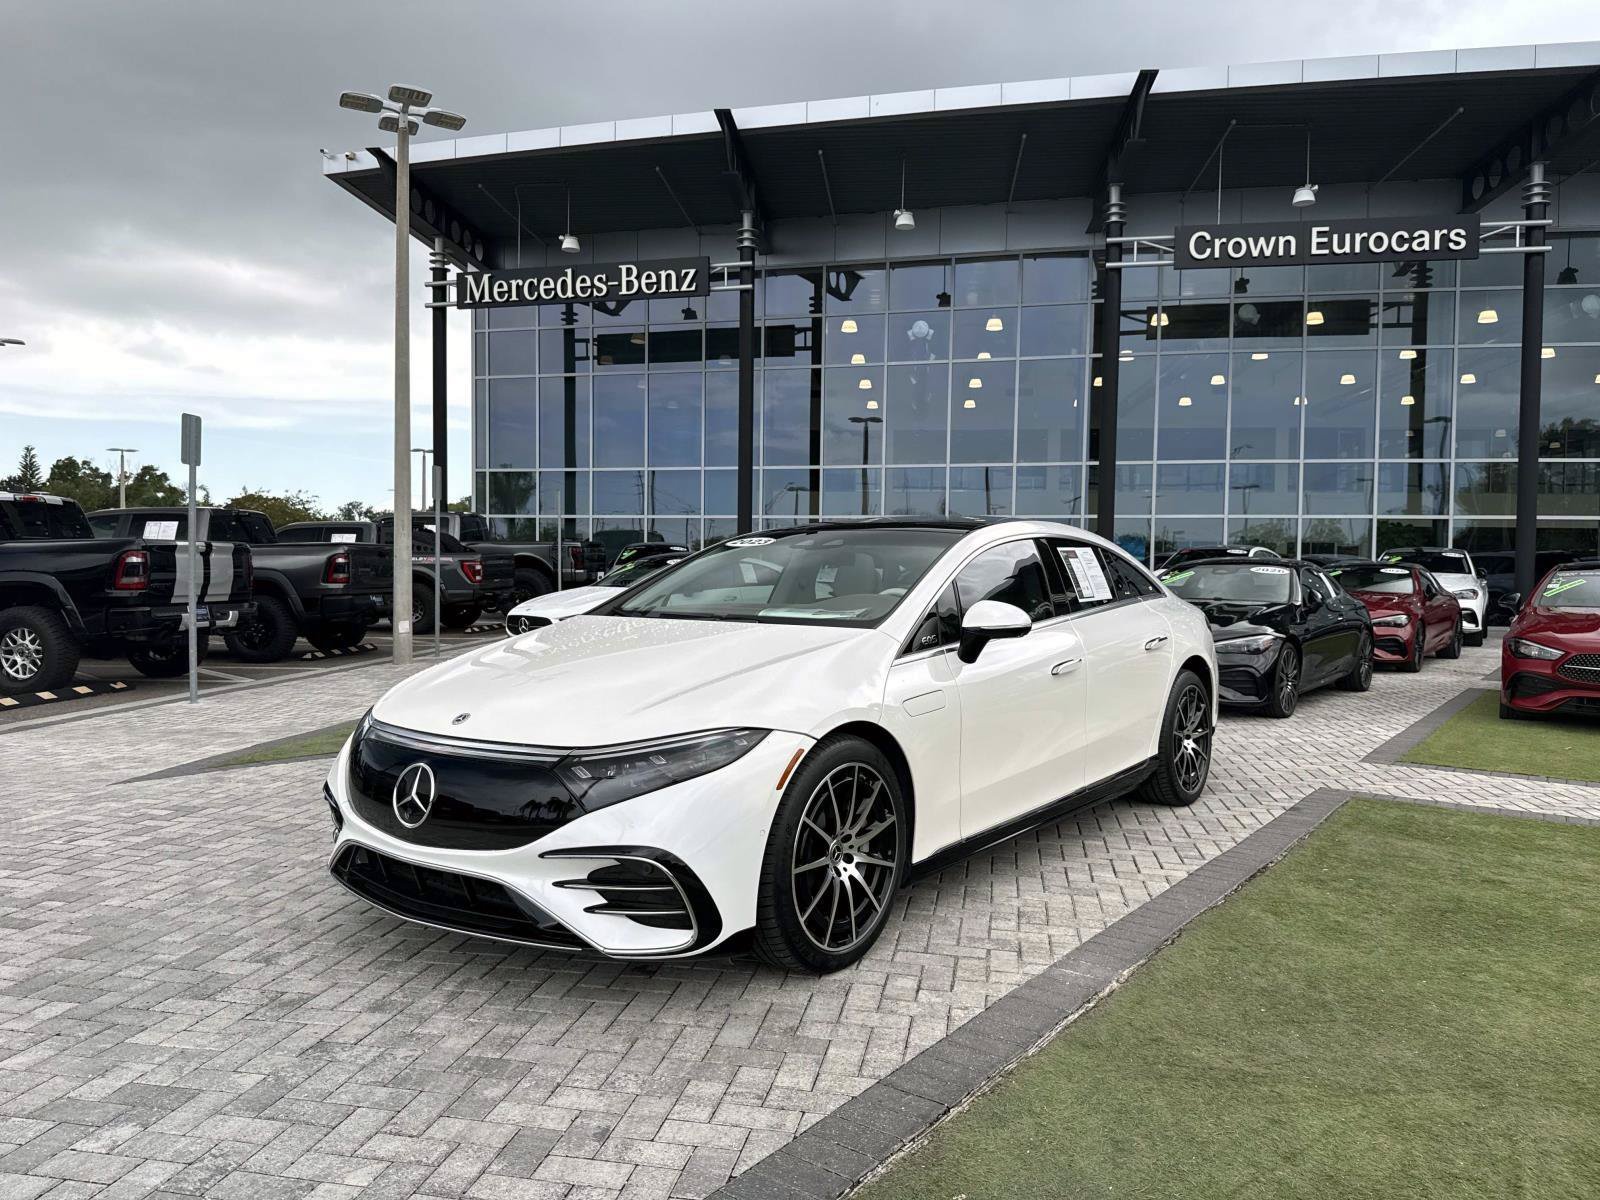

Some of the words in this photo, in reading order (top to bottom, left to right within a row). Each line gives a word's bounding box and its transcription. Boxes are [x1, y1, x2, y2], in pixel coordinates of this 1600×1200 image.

[1188, 231, 1296, 259] Crown
[1310, 226, 1467, 256] Eurocars
[463, 264, 697, 304] Mercedes-Benz
